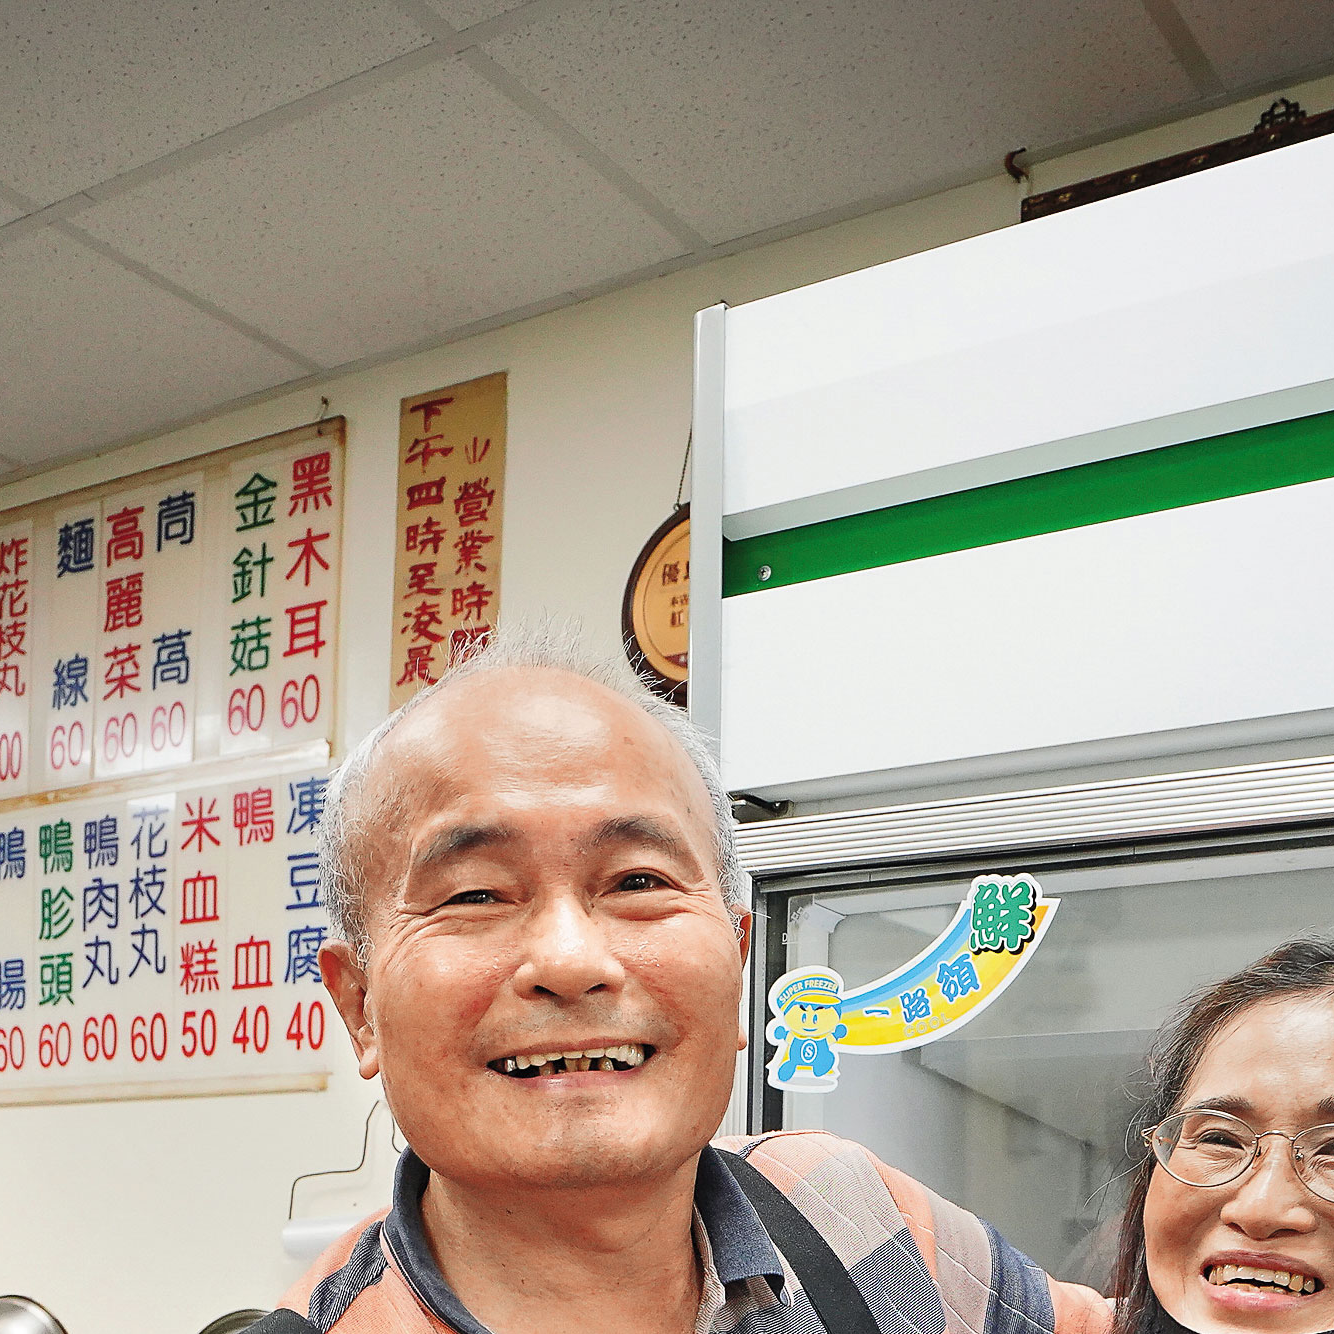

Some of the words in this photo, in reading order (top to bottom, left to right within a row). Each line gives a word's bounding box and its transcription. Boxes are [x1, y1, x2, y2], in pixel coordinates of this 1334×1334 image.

[282, 451, 333, 659] 黑木耳
[396, 396, 455, 688] 下午四時至凌晨
[228, 471, 279, 678] 金針菇
[51, 517, 95, 711] 麵線
[103, 505, 146, 701] 高麗菜
[150, 700, 186, 752] 60
[227, 682, 266, 737] 60
[280, 673, 321, 729] 60
[50, 719, 84, 770] 60
[103, 711, 138, 763] 60
[38, 817, 75, 1008] 鴨胗頭
[82, 813, 120, 990] 鴨肉丸
[127, 804, 168, 979] 花枝丸
[179, 796, 222, 997] 米血糕
[231, 786, 275, 992] 鴨血
[778, 980, 804, 1005] SUPER
[805, 978, 839, 993] FREEZER
[38, 1021, 72, 1068] 60
[83, 1013, 117, 1063] 60
[130, 1012, 167, 1062] 60
[181, 1008, 217, 1059] 50
[232, 1004, 270, 1055] 40
[286, 1001, 325, 1051] 40
[903, 1013, 953, 1038] COOL
